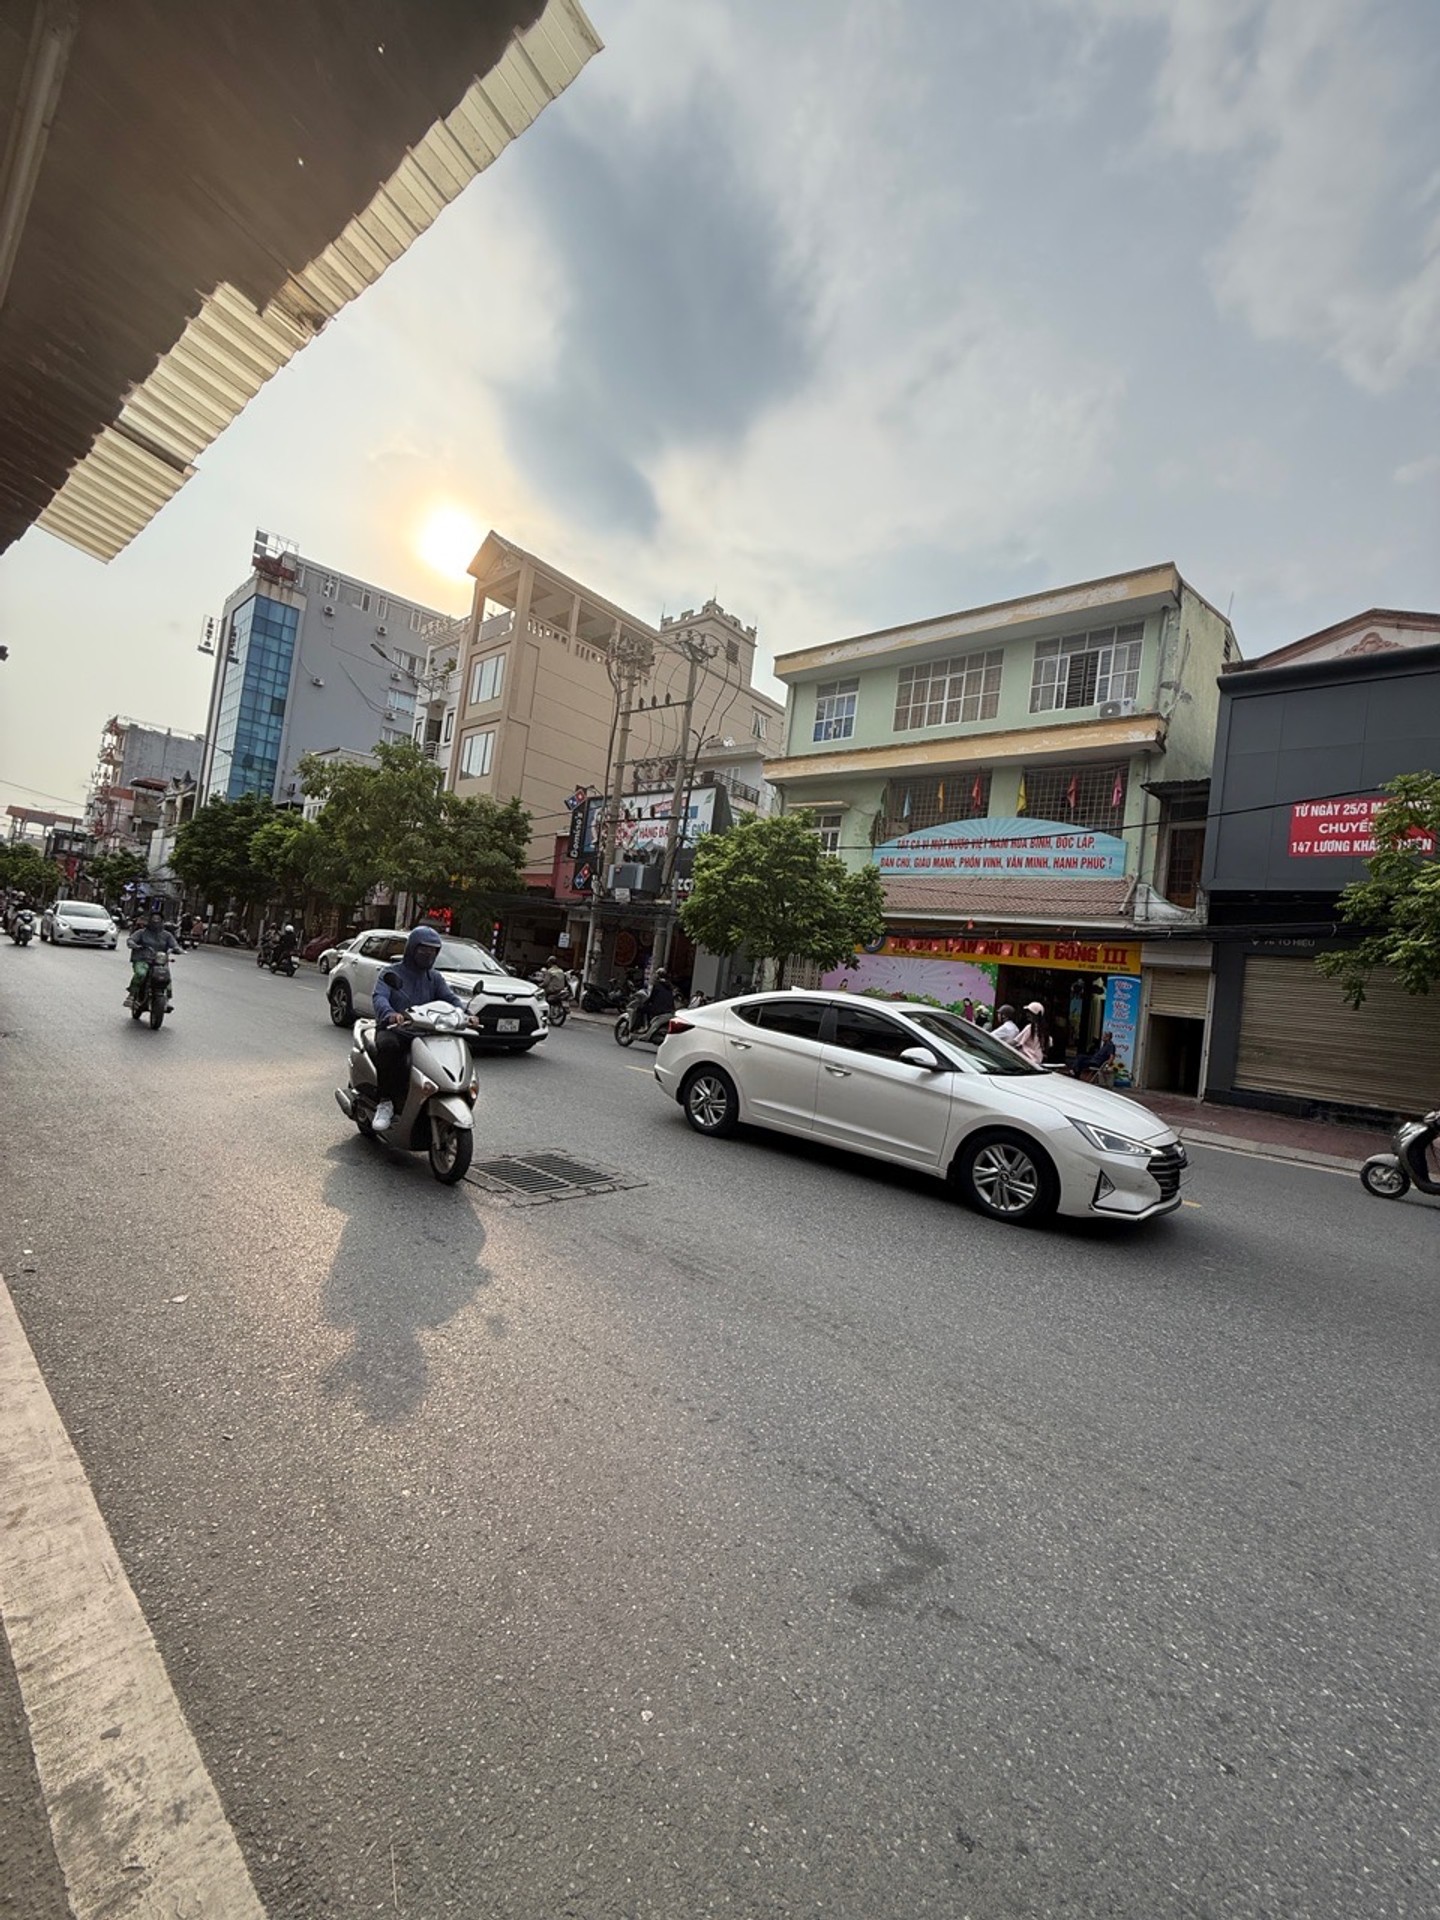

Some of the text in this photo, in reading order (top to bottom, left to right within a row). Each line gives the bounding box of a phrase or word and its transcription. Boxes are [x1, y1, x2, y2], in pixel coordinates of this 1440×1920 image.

[1295, 803, 1309, 817] TỪ
[1311, 802, 1340, 816] NGÀY
[1343, 802, 1367, 815] 25/3
[570, 812, 583, 858] Domino's
[1292, 841, 1311, 853] 147
[1053, 857, 1078, 871] HẠNH
[1017, 942, 1050, 960] KM
[1103, 948, 1128, 965] III
